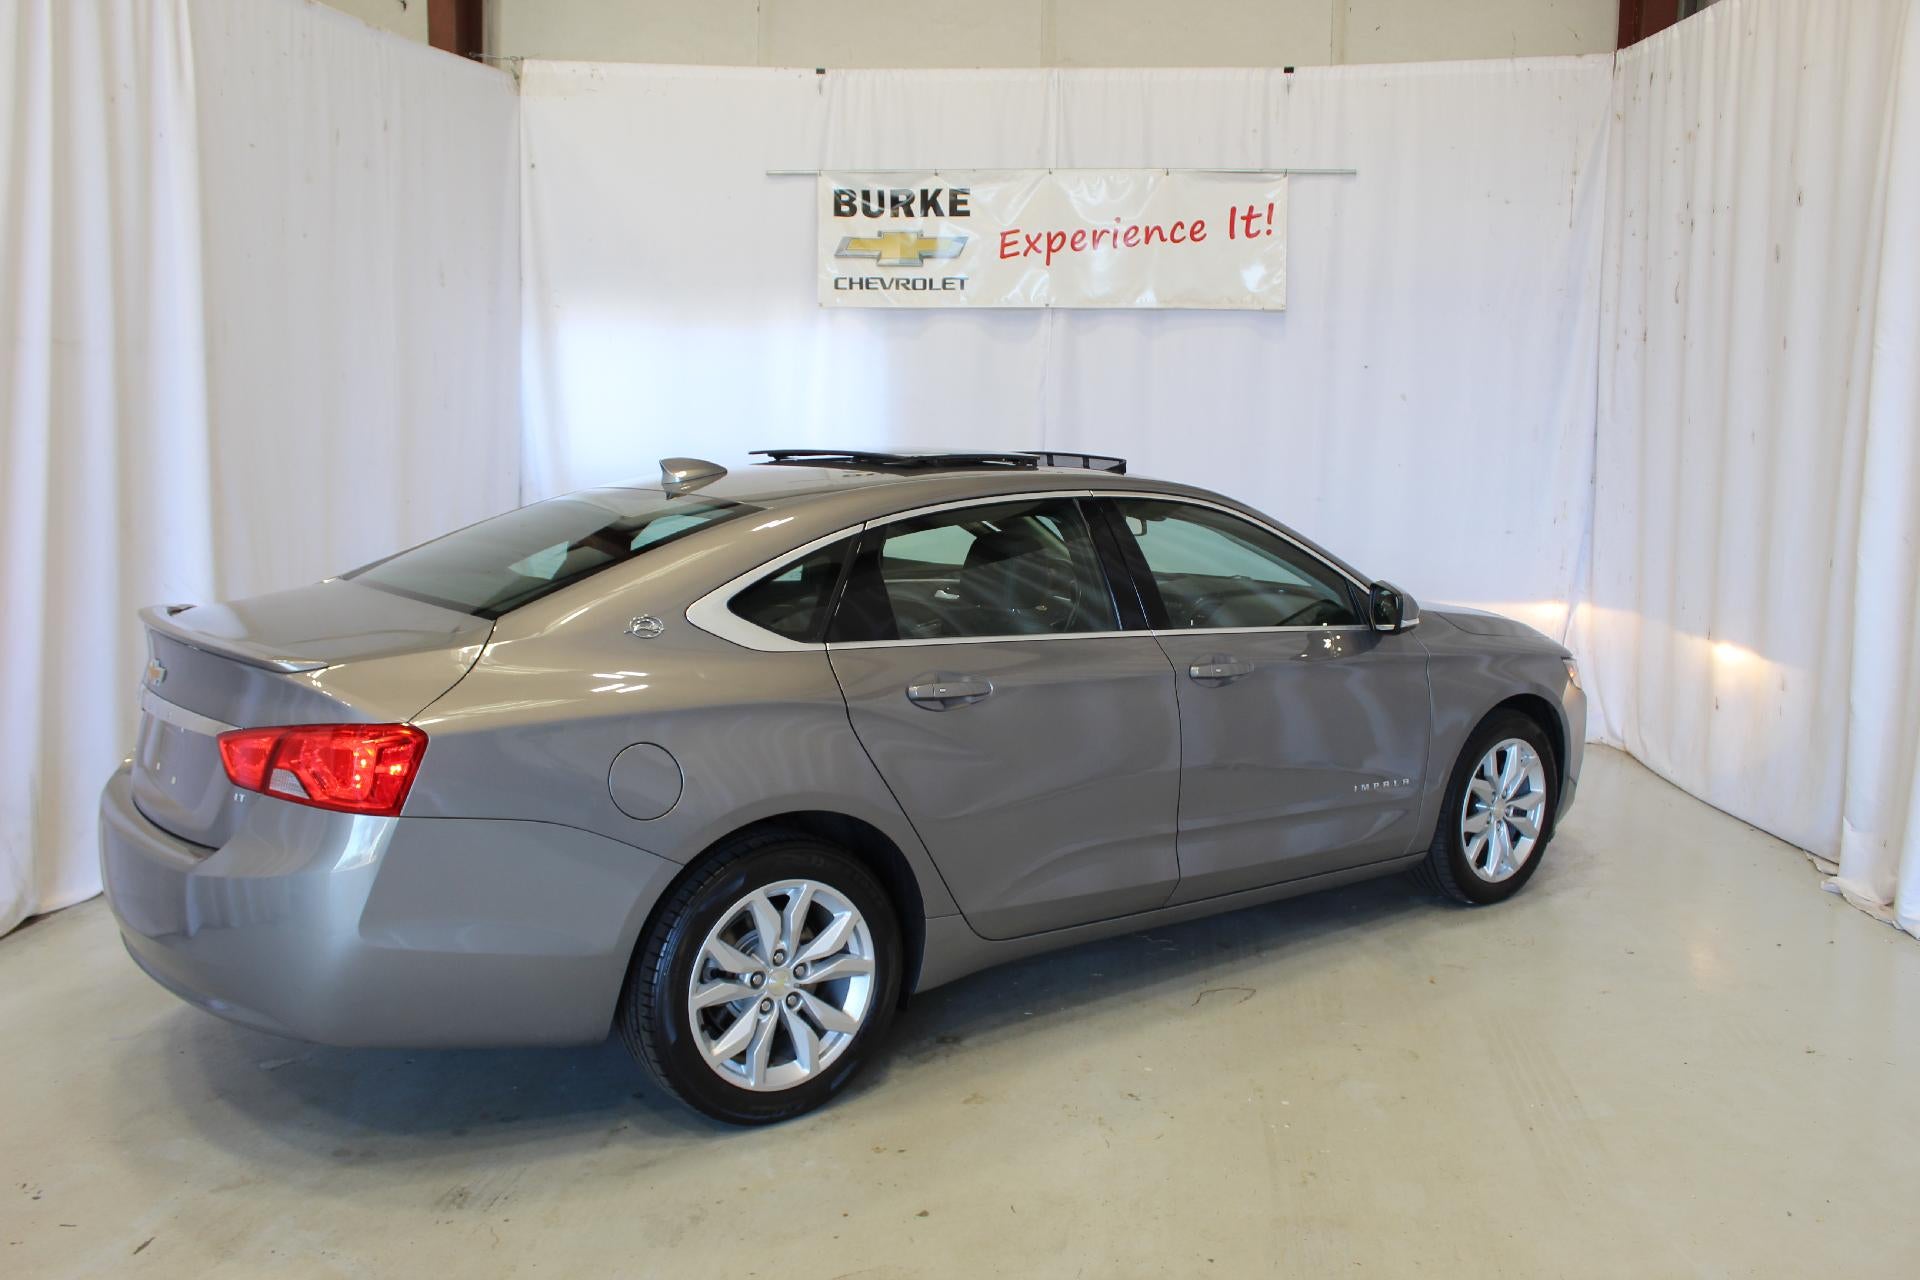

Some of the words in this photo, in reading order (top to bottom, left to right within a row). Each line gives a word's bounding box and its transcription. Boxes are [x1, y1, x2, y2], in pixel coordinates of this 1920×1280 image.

[833, 187, 970, 218] BURKE
[999, 217, 1207, 266] Experience
[1229, 202, 1275, 240] It!
[833, 276, 968, 291] CHEVROLET
[1353, 778, 1410, 793] IMPALA
